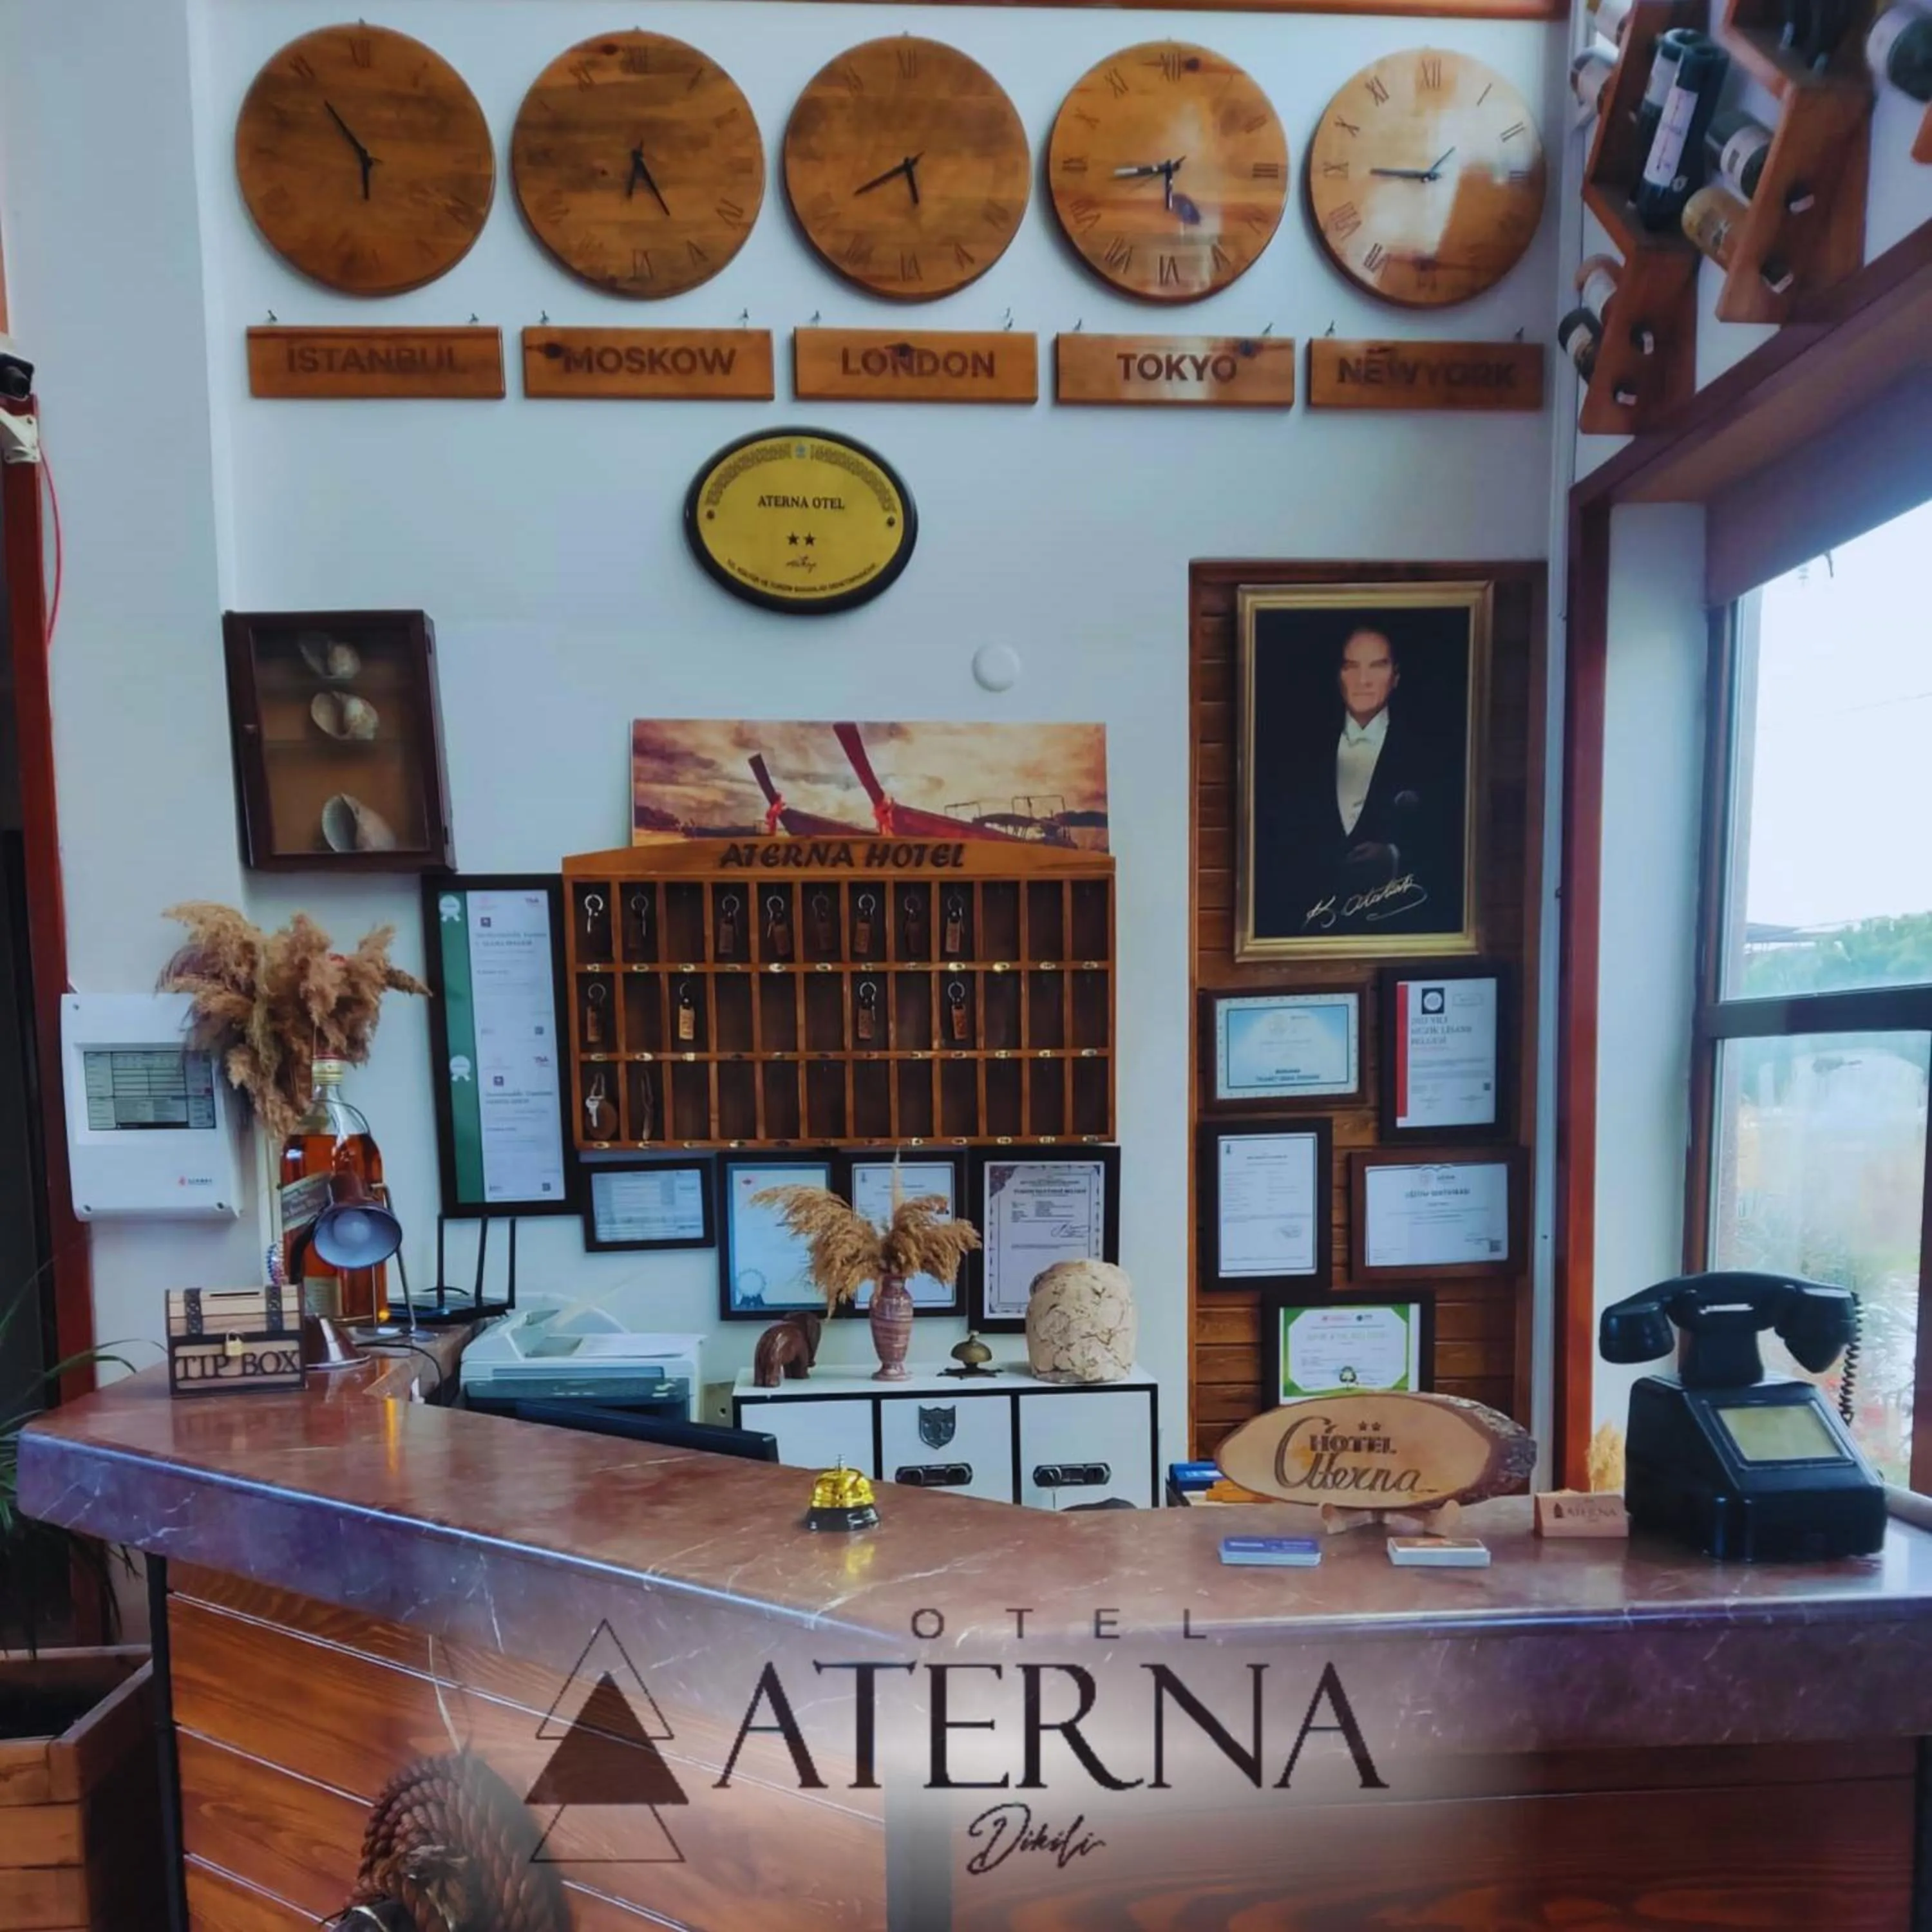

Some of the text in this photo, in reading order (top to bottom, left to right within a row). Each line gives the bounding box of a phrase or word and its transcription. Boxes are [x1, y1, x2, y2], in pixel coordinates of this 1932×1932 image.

[1421, 58, 1442, 90] XII
[1364, 75, 1390, 107] XI
[564, 346, 737, 375] MOSKOW
[842, 346, 996, 379] LONDON
[1117, 353, 1238, 383] TOKYO
[757, 495, 845, 509] ATERNA OTEL
[719, 842, 968, 869] ATERNA HOTEL
[175, 1349, 300, 1381] TIP BOX
[1309, 1435, 1397, 1454] HOTEL
